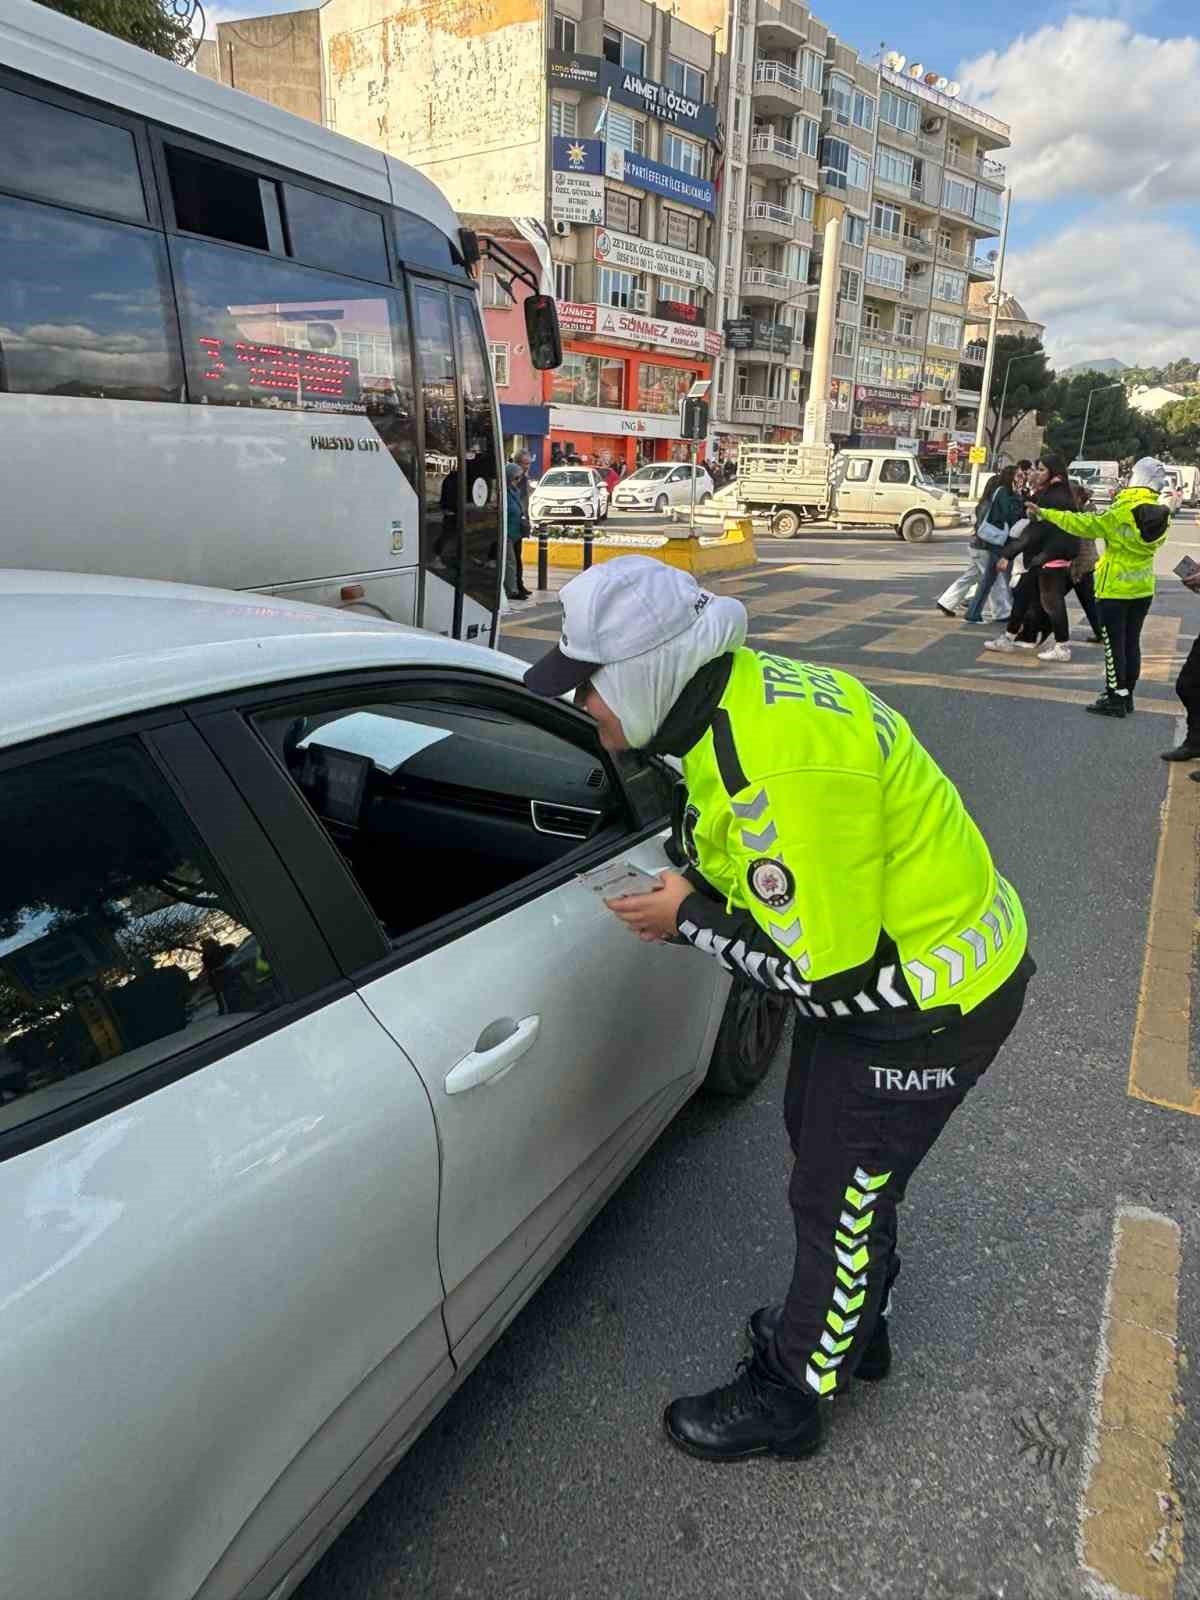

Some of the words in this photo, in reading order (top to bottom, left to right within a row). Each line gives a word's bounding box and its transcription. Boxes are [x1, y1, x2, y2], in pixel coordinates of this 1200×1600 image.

[623, 74, 658, 101] AHMET
[667, 89, 700, 119] ÖZSOY
[612, 238, 639, 254] ZEYBEK
[621, 420, 636, 432] ING
